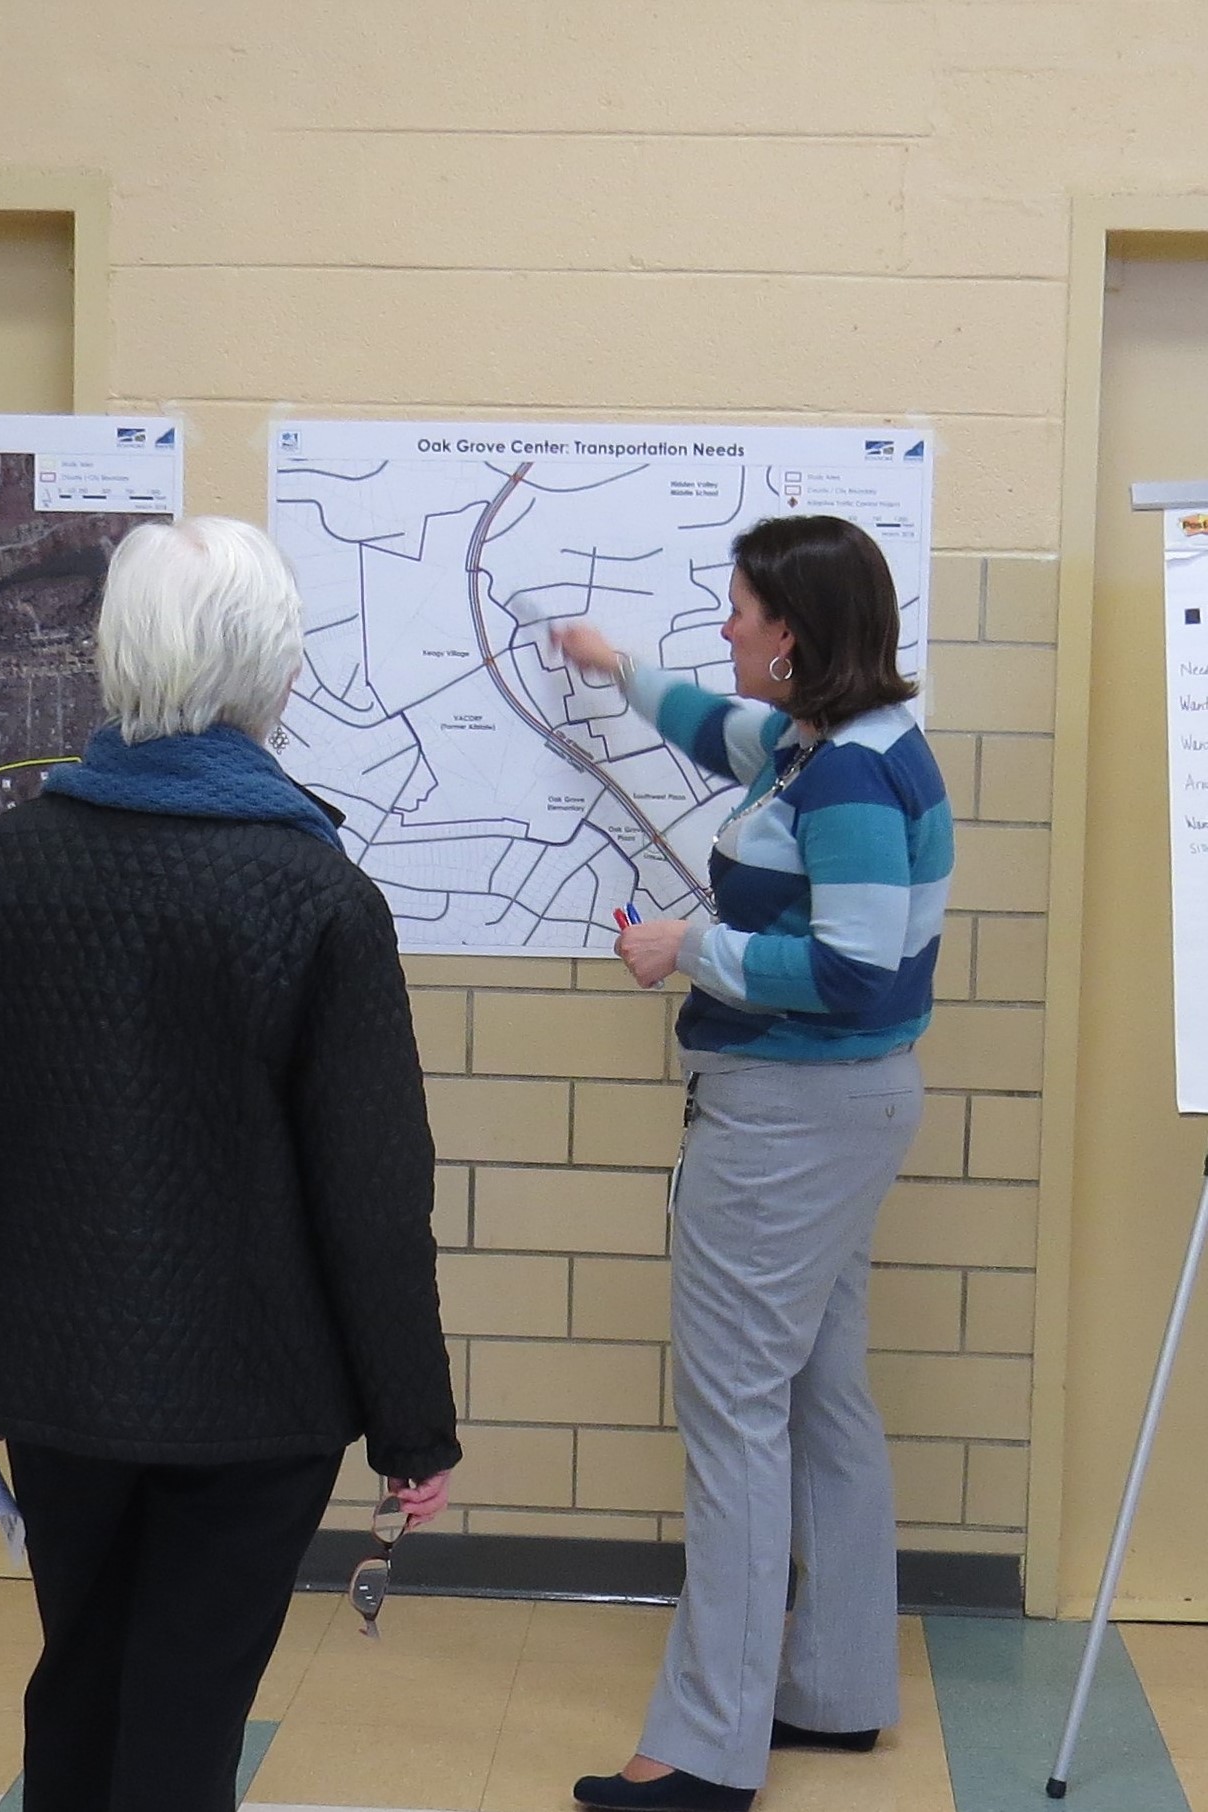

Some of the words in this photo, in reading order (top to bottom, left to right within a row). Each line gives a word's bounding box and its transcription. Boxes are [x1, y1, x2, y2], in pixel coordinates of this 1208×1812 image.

[417, 438, 452, 453] Oak
[456, 439, 506, 454] Grove
[510, 440, 570, 455] Center:
[574, 440, 688, 458] Transportation
[693, 442, 745, 457] Needs
[446, 650, 470, 658] Village
[546, 804, 585, 812] Elementary
